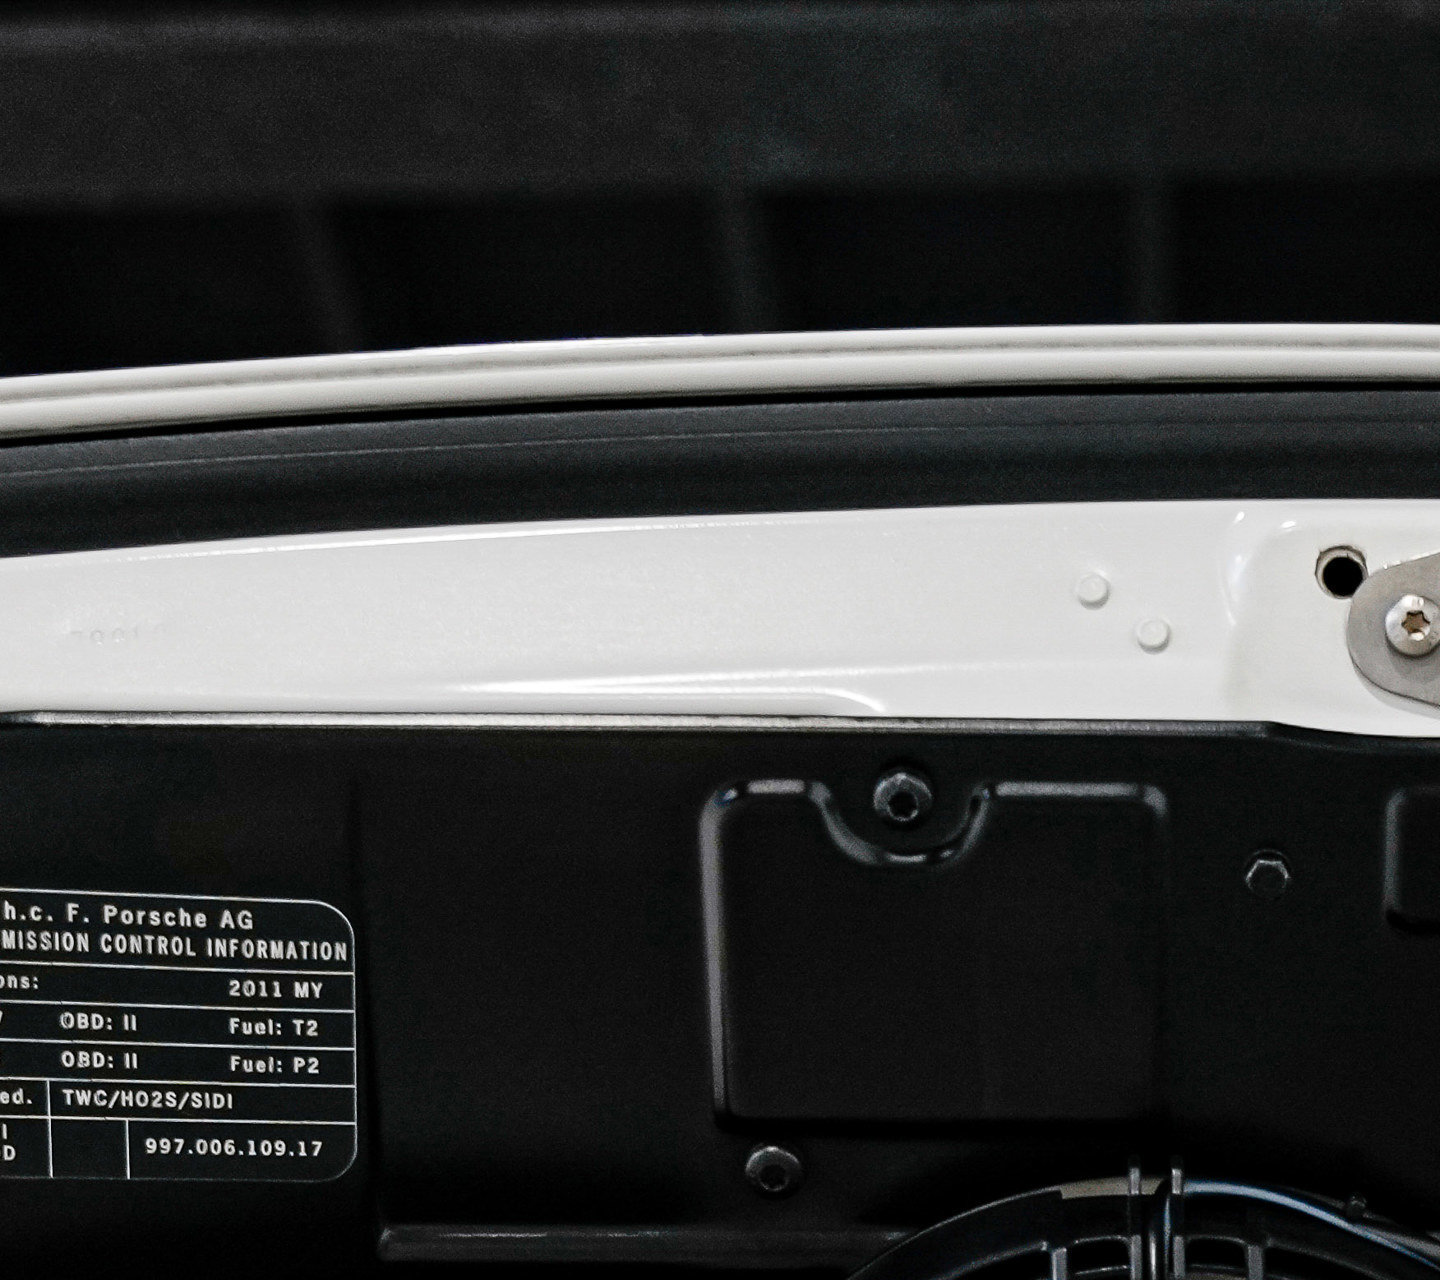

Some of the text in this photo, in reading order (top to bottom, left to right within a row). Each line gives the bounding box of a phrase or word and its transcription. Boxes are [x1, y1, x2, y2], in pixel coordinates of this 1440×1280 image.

[3, 900, 53, 922] h.c.
[67, 902, 89, 923] F.
[103, 904, 207, 928] Porsche
[219, 909, 253, 930] AG
[100, 933, 196, 957] CONTROL
[207, 938, 347, 961] INFORMATION
[228, 979, 324, 999] 2011 MY
[60, 1012, 137, 1032] OBD: II
[228, 1017, 319, 1037] Fuel: T2
[61, 1051, 137, 1069] OBD: II
[230, 1055, 320, 1074] Fuel: P2
[145, 1138, 323, 1157] 997.006.109.17
